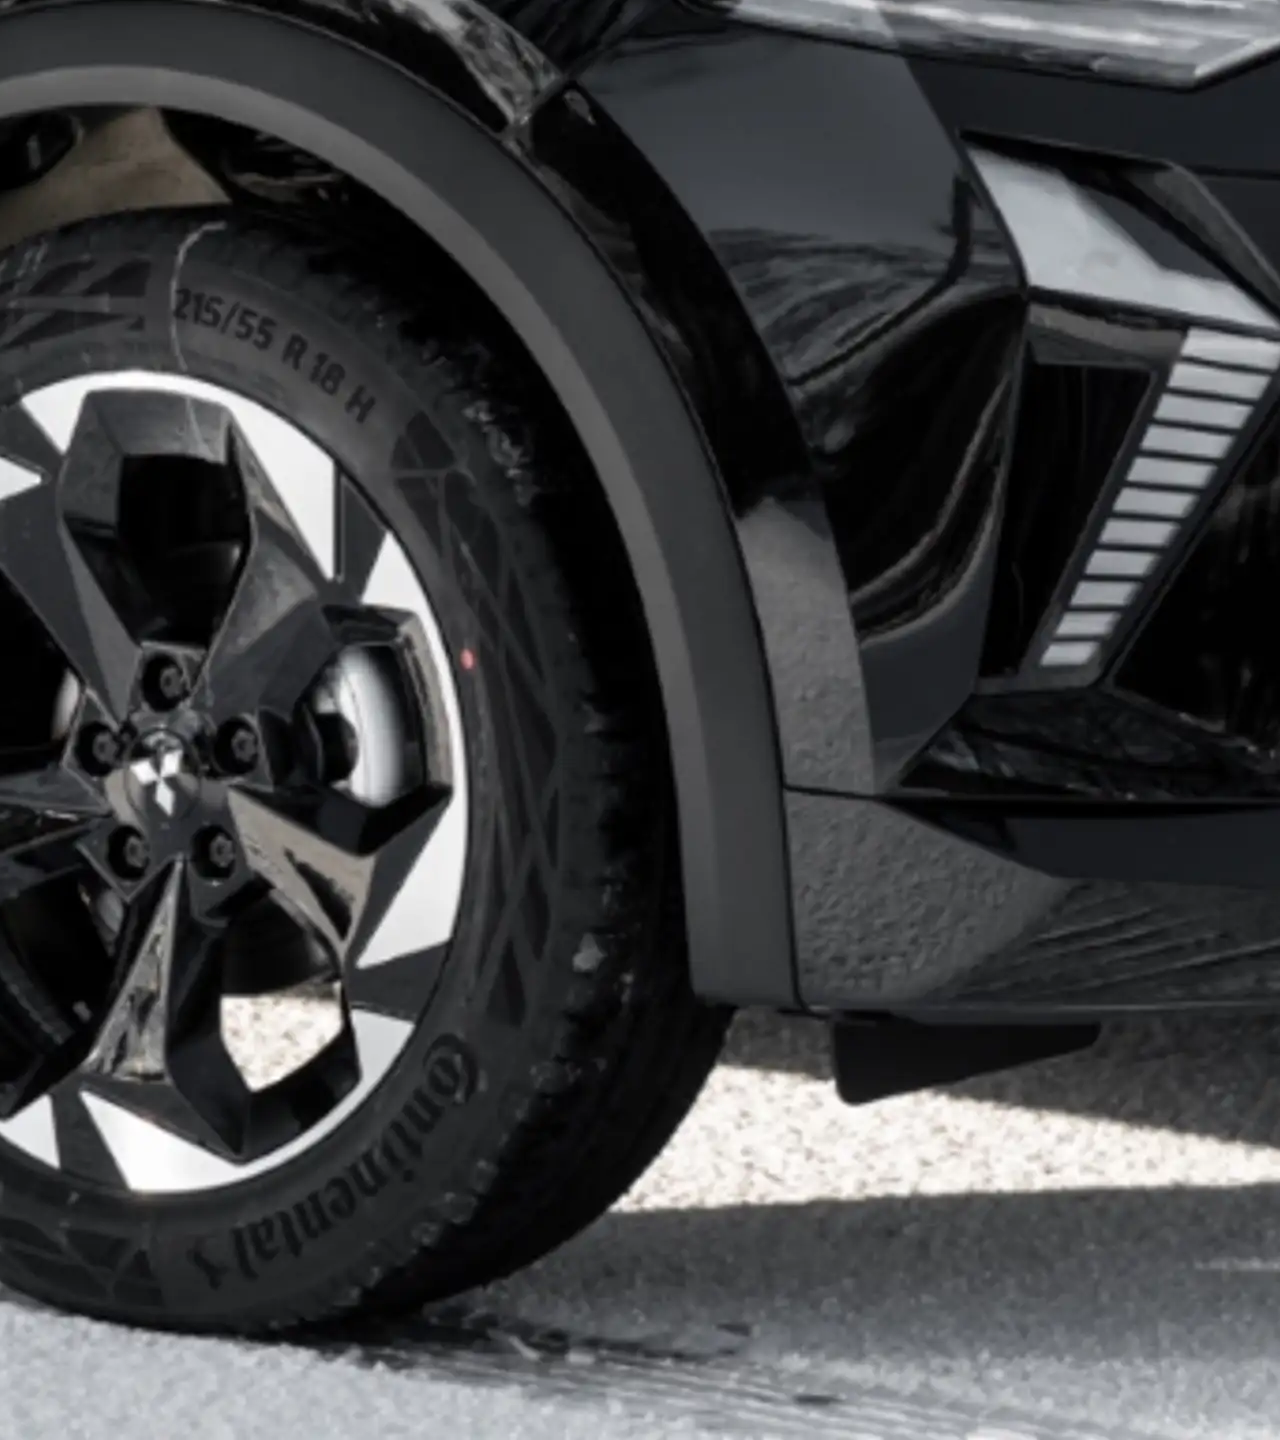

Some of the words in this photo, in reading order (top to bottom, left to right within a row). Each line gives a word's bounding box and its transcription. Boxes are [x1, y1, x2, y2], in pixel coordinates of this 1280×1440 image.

[172, 287, 278, 351] 215/55
[281, 333, 309, 372] R
[308, 351, 347, 397] 18
[343, 384, 377, 424] H
[230, 1031, 480, 1282] Continental
